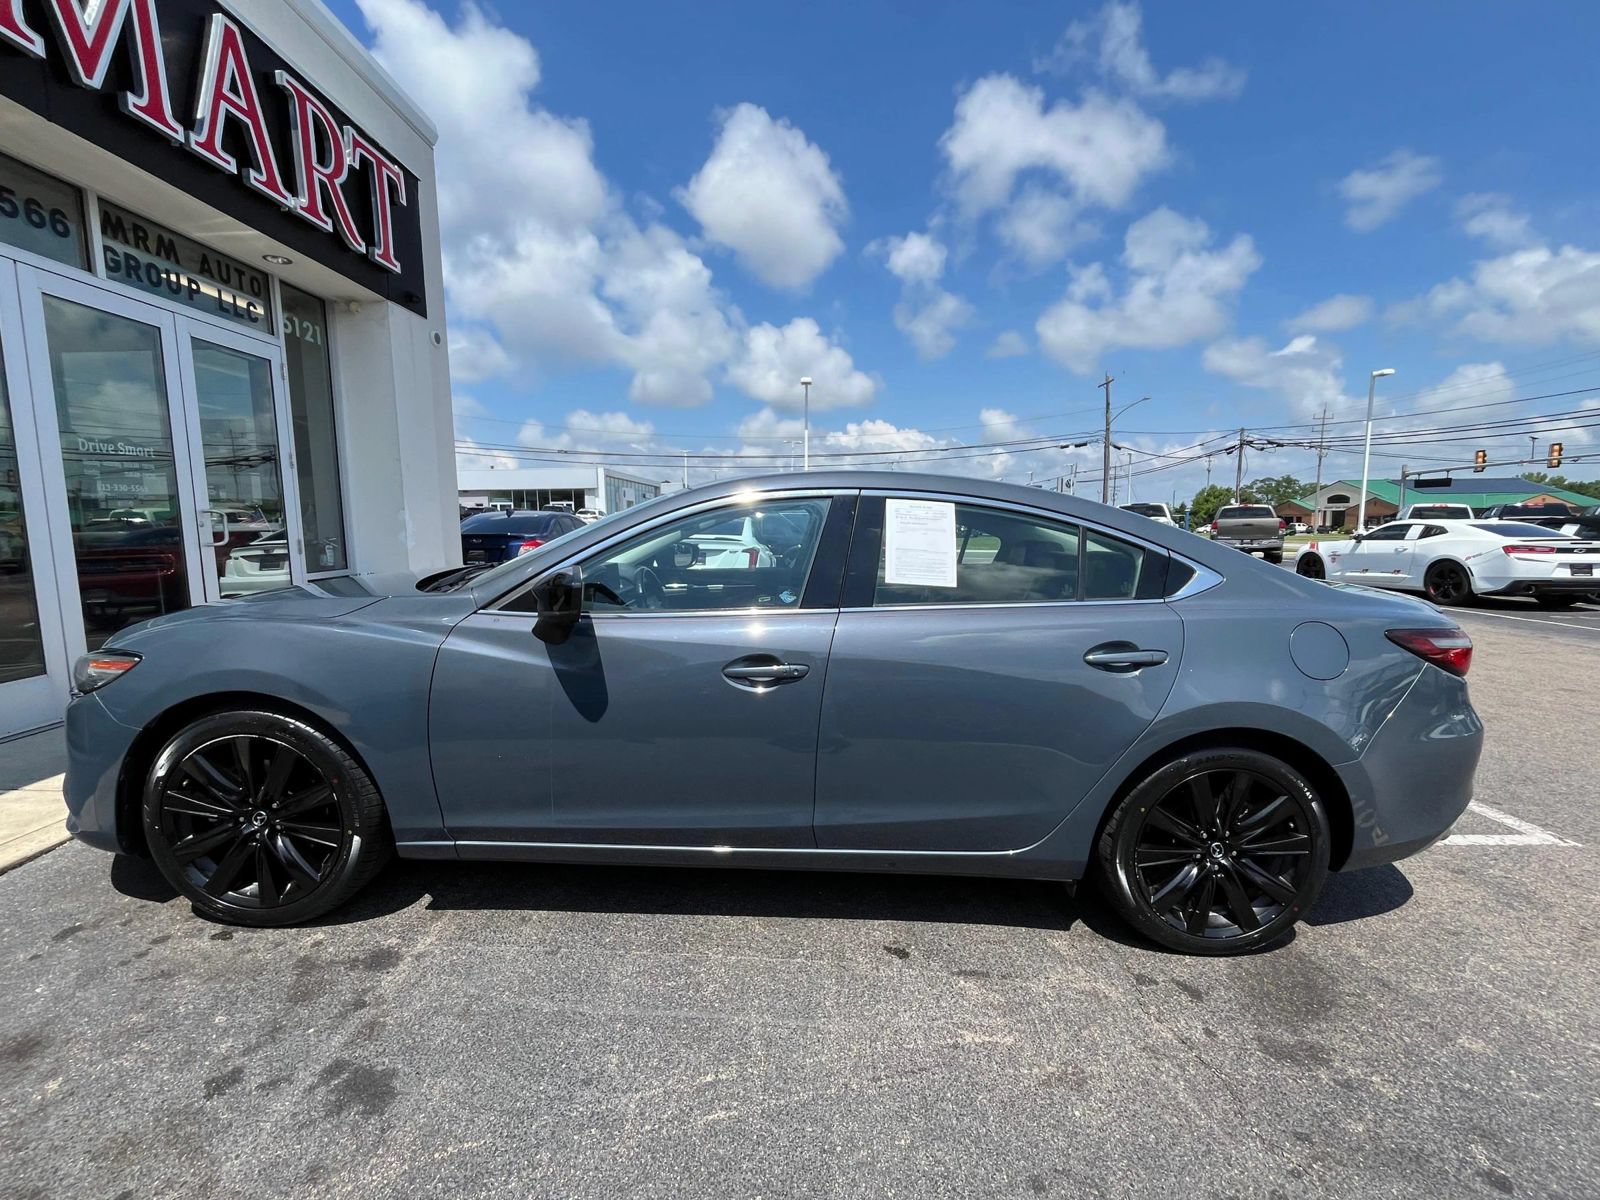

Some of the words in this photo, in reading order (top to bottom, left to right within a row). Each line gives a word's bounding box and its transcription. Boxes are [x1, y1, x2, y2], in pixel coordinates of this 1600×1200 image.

[0, 0, 406, 274] MART
[101, 209, 181, 266] MRM
[200, 253, 262, 298] AUTO
[103, 244, 201, 302] GROUP
[217, 288, 259, 323] LLC
[78, 438, 115, 454] Drive
[117, 442, 156, 458] Smart
